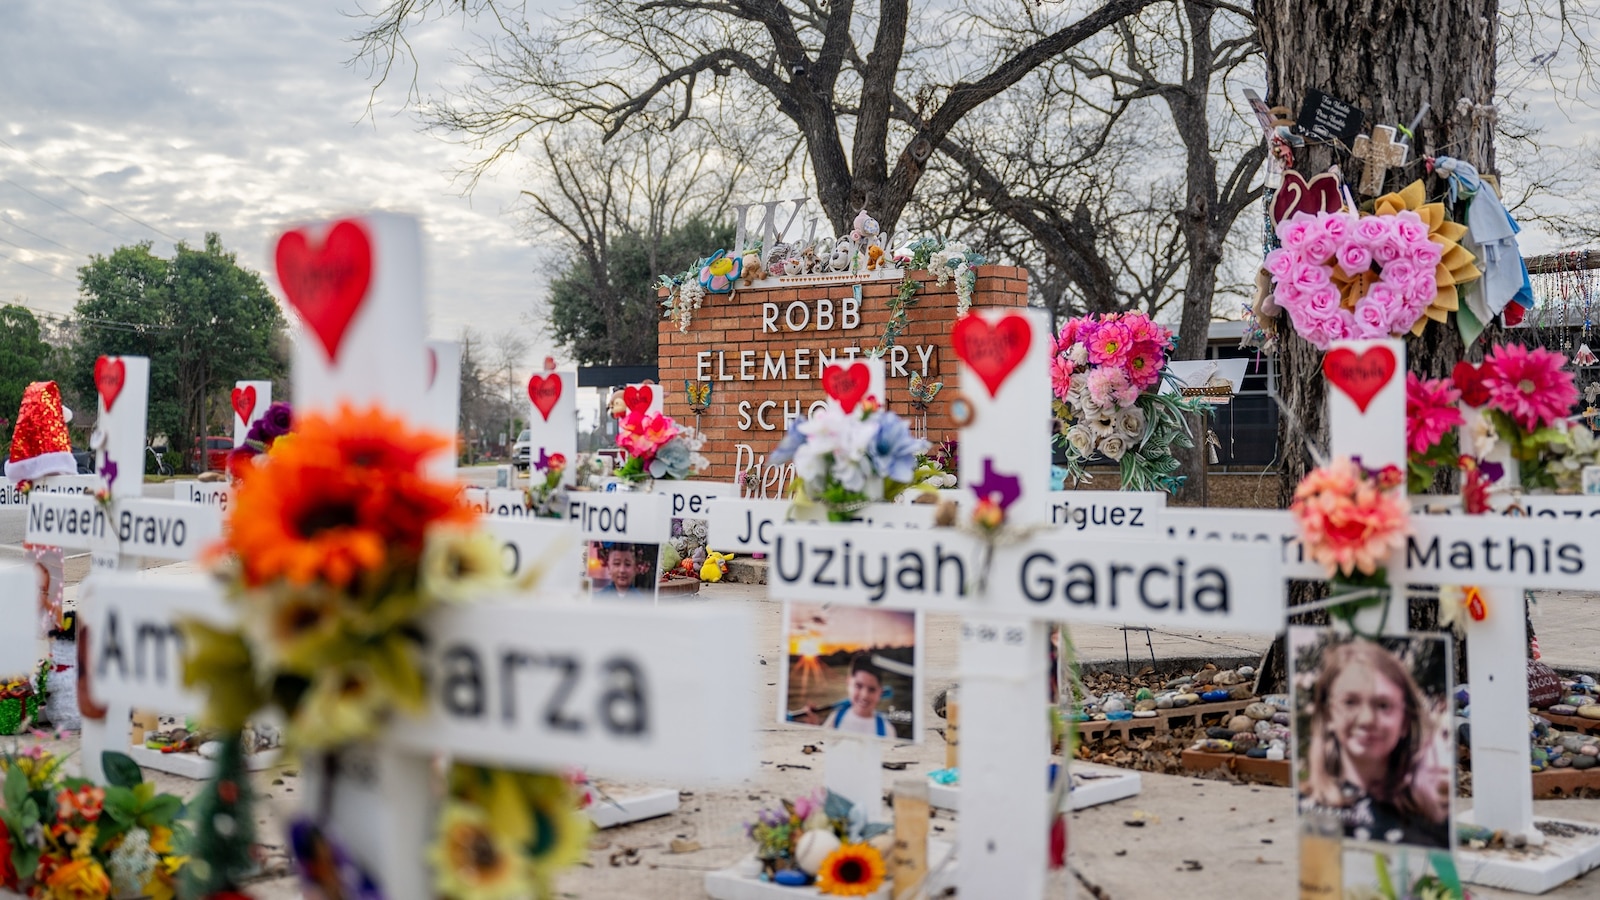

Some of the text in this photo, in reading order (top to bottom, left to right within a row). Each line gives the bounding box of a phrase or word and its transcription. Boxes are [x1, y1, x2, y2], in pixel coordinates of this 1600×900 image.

[762, 298, 860, 333] ROBB
[738, 400, 829, 431] SCHO
[29, 502, 187, 547] Nevaeh Bravo
[1052, 501, 1144, 531] riguez
[774, 534, 1232, 614] Uziyah Garcia
[1405, 534, 1585, 576] Mathis
[440, 642, 654, 738] arza
